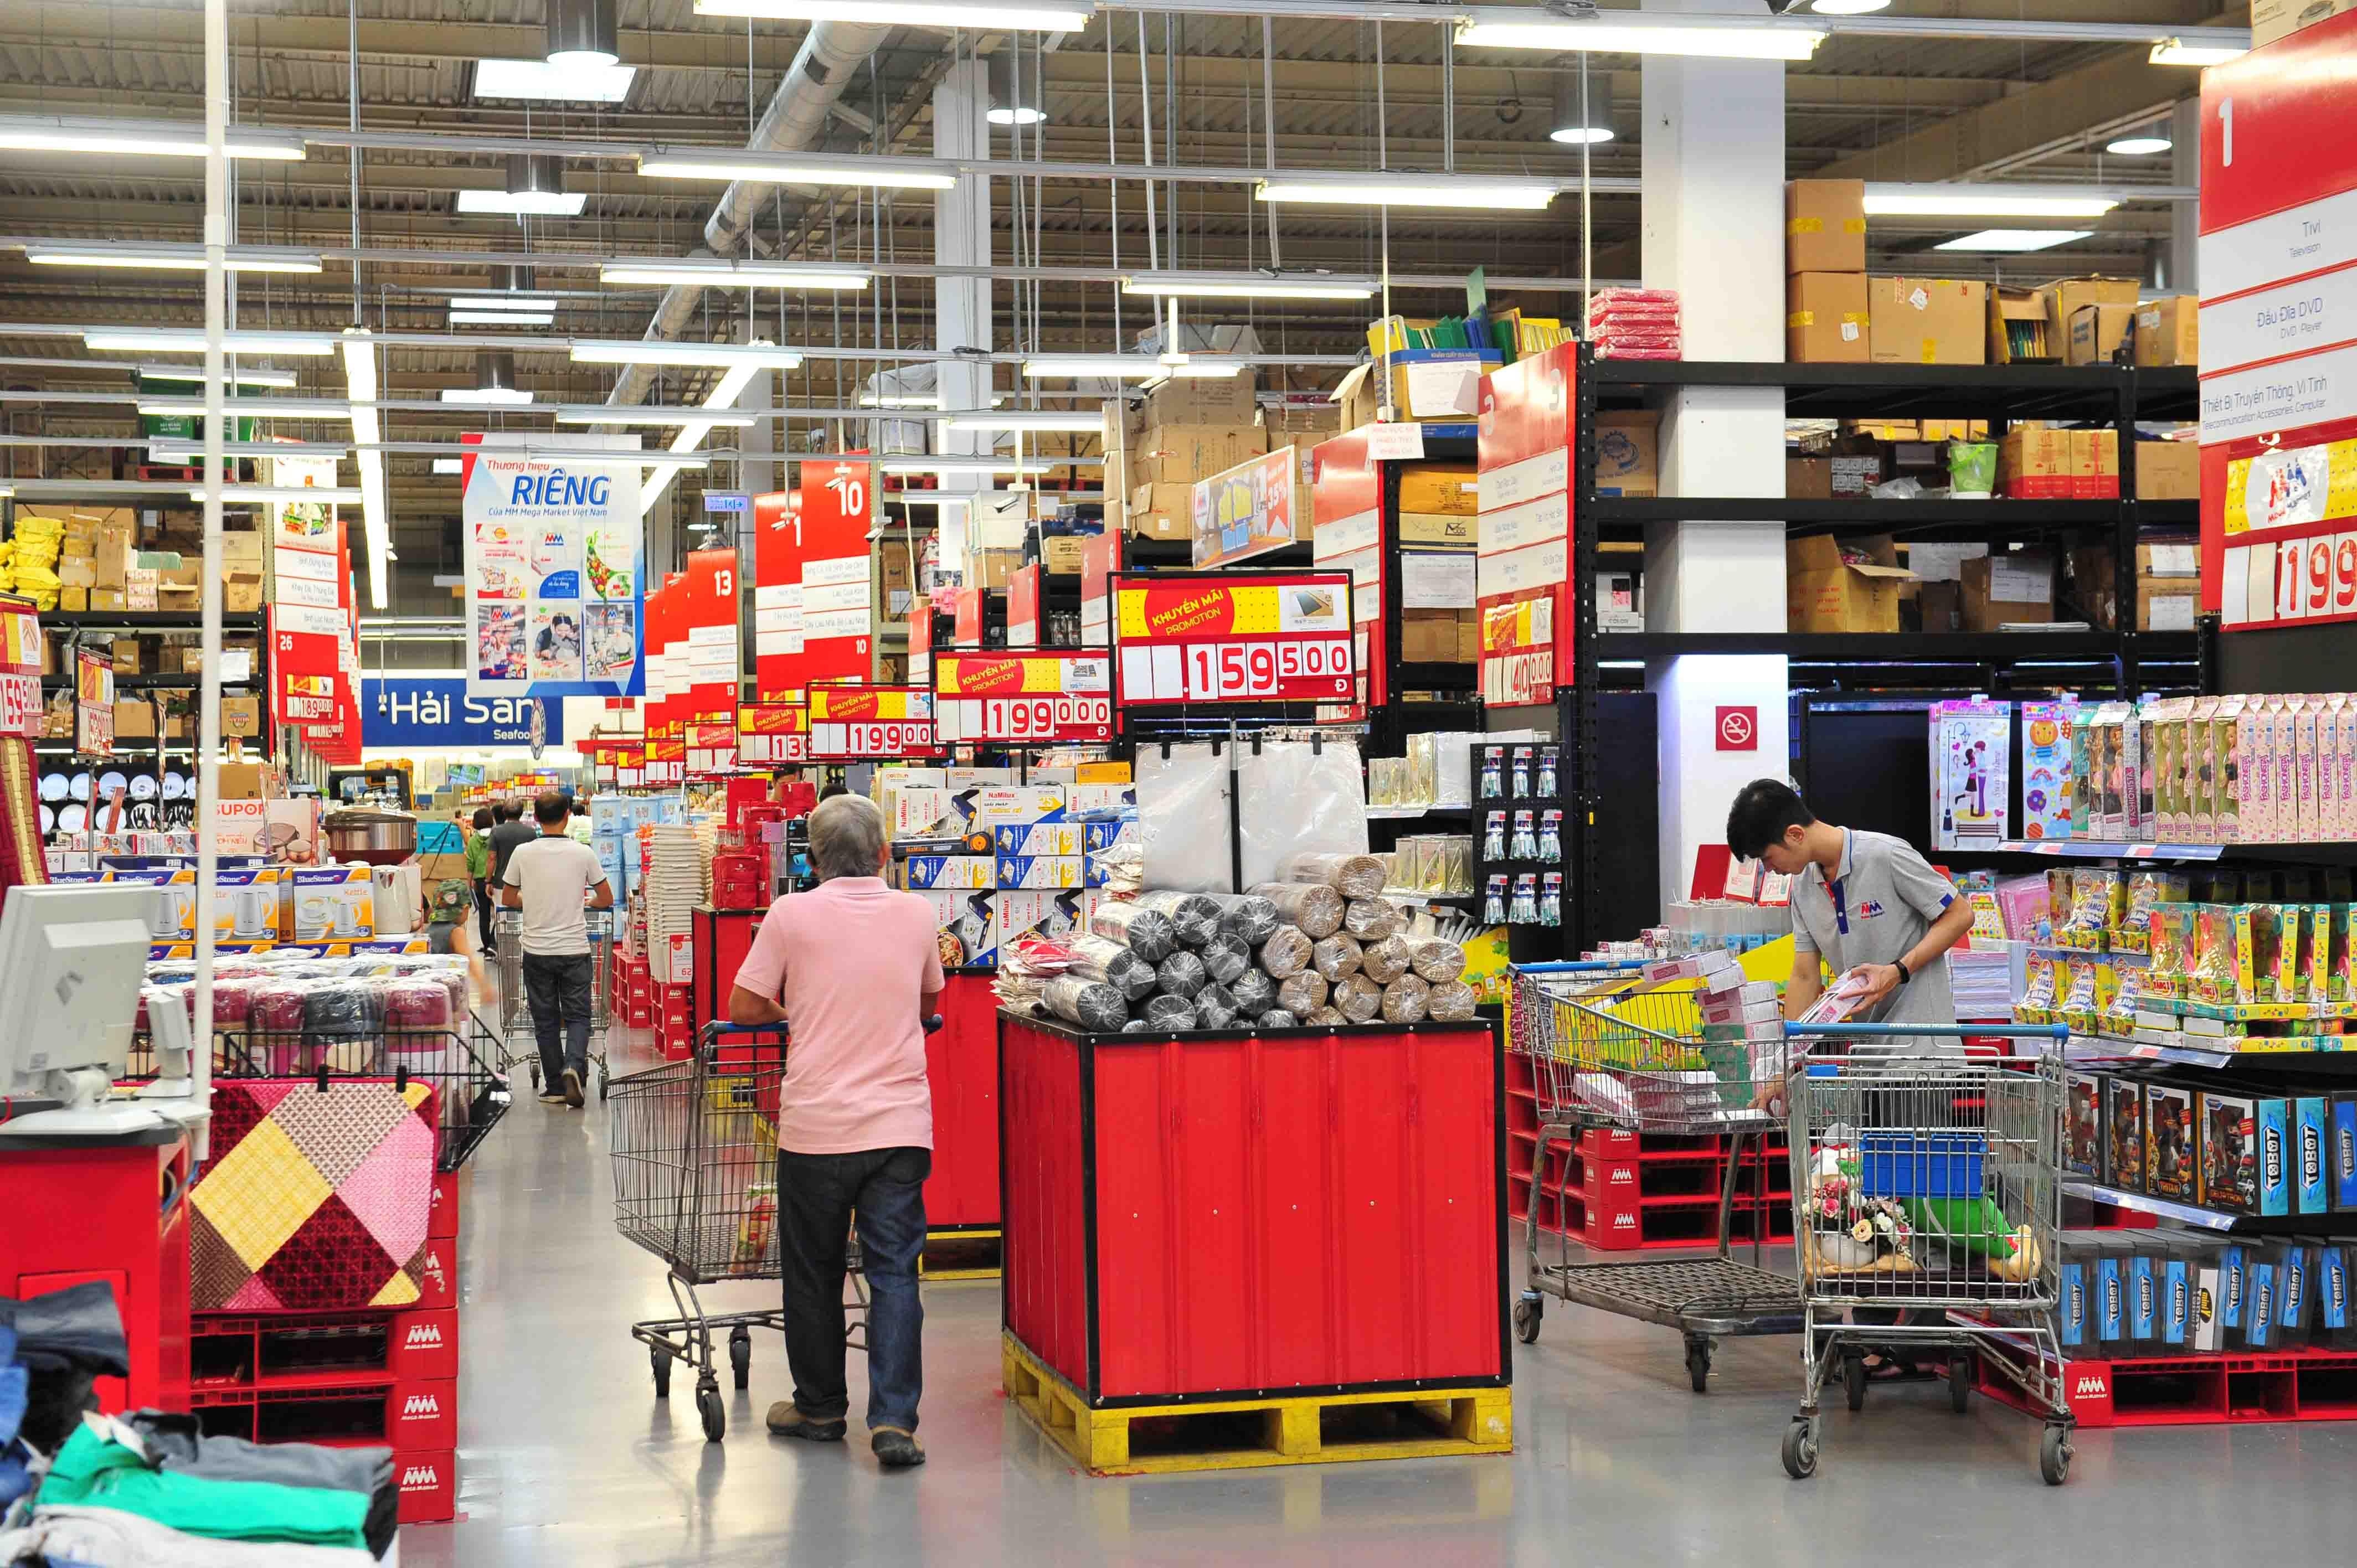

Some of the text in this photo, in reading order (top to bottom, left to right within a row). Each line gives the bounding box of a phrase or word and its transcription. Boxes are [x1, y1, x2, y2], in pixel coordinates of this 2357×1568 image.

[2219, 97, 2233, 167] 1
[2299, 297, 2323, 317] DVD
[511, 468, 611, 506] RIÊNG
[838, 481, 863, 516] 10
[520, 508, 541, 518] Mega
[543, 507, 570, 516] Market
[590, 508, 608, 517] Nam
[713, 570, 732, 597] 13
[1151, 598, 1200, 627] KHUYẾN
[1165, 606, 1222, 636] PROMOTION
[280, 635, 293, 651] 26
[856, 639, 867, 654] 10
[971, 672, 1015, 692] PROMOTION
[391, 690, 450, 725] Hải
[837, 703, 871, 718] PROMOTION
[493, 729, 533, 740] Seafoo
[217, 803, 266, 816] UPO
[2127, 768, 2139, 826] FASHIONISTA
[296, 875, 334, 883] BlueStone
[354, 945, 390, 953] BlueStone
[2266, 1127, 2279, 1188] TOBOT
[2304, 1126, 2318, 1187] TOBOT
[2342, 1128, 2353, 1178] TOBOT
[2108, 1278, 2119, 1322] TOBOT
[2140, 1276, 2152, 1320] TOBOT
[2175, 1281, 2186, 1324] TOBOT
[2229, 1265, 2242, 1309] TOBOT
[2288, 1265, 2303, 1309] TOBOT
[2331, 1265, 2345, 1310] TOBOT
[2071, 1283, 2083, 1327] TOBOT
[2258, 1284, 2272, 1328] TOBOT
